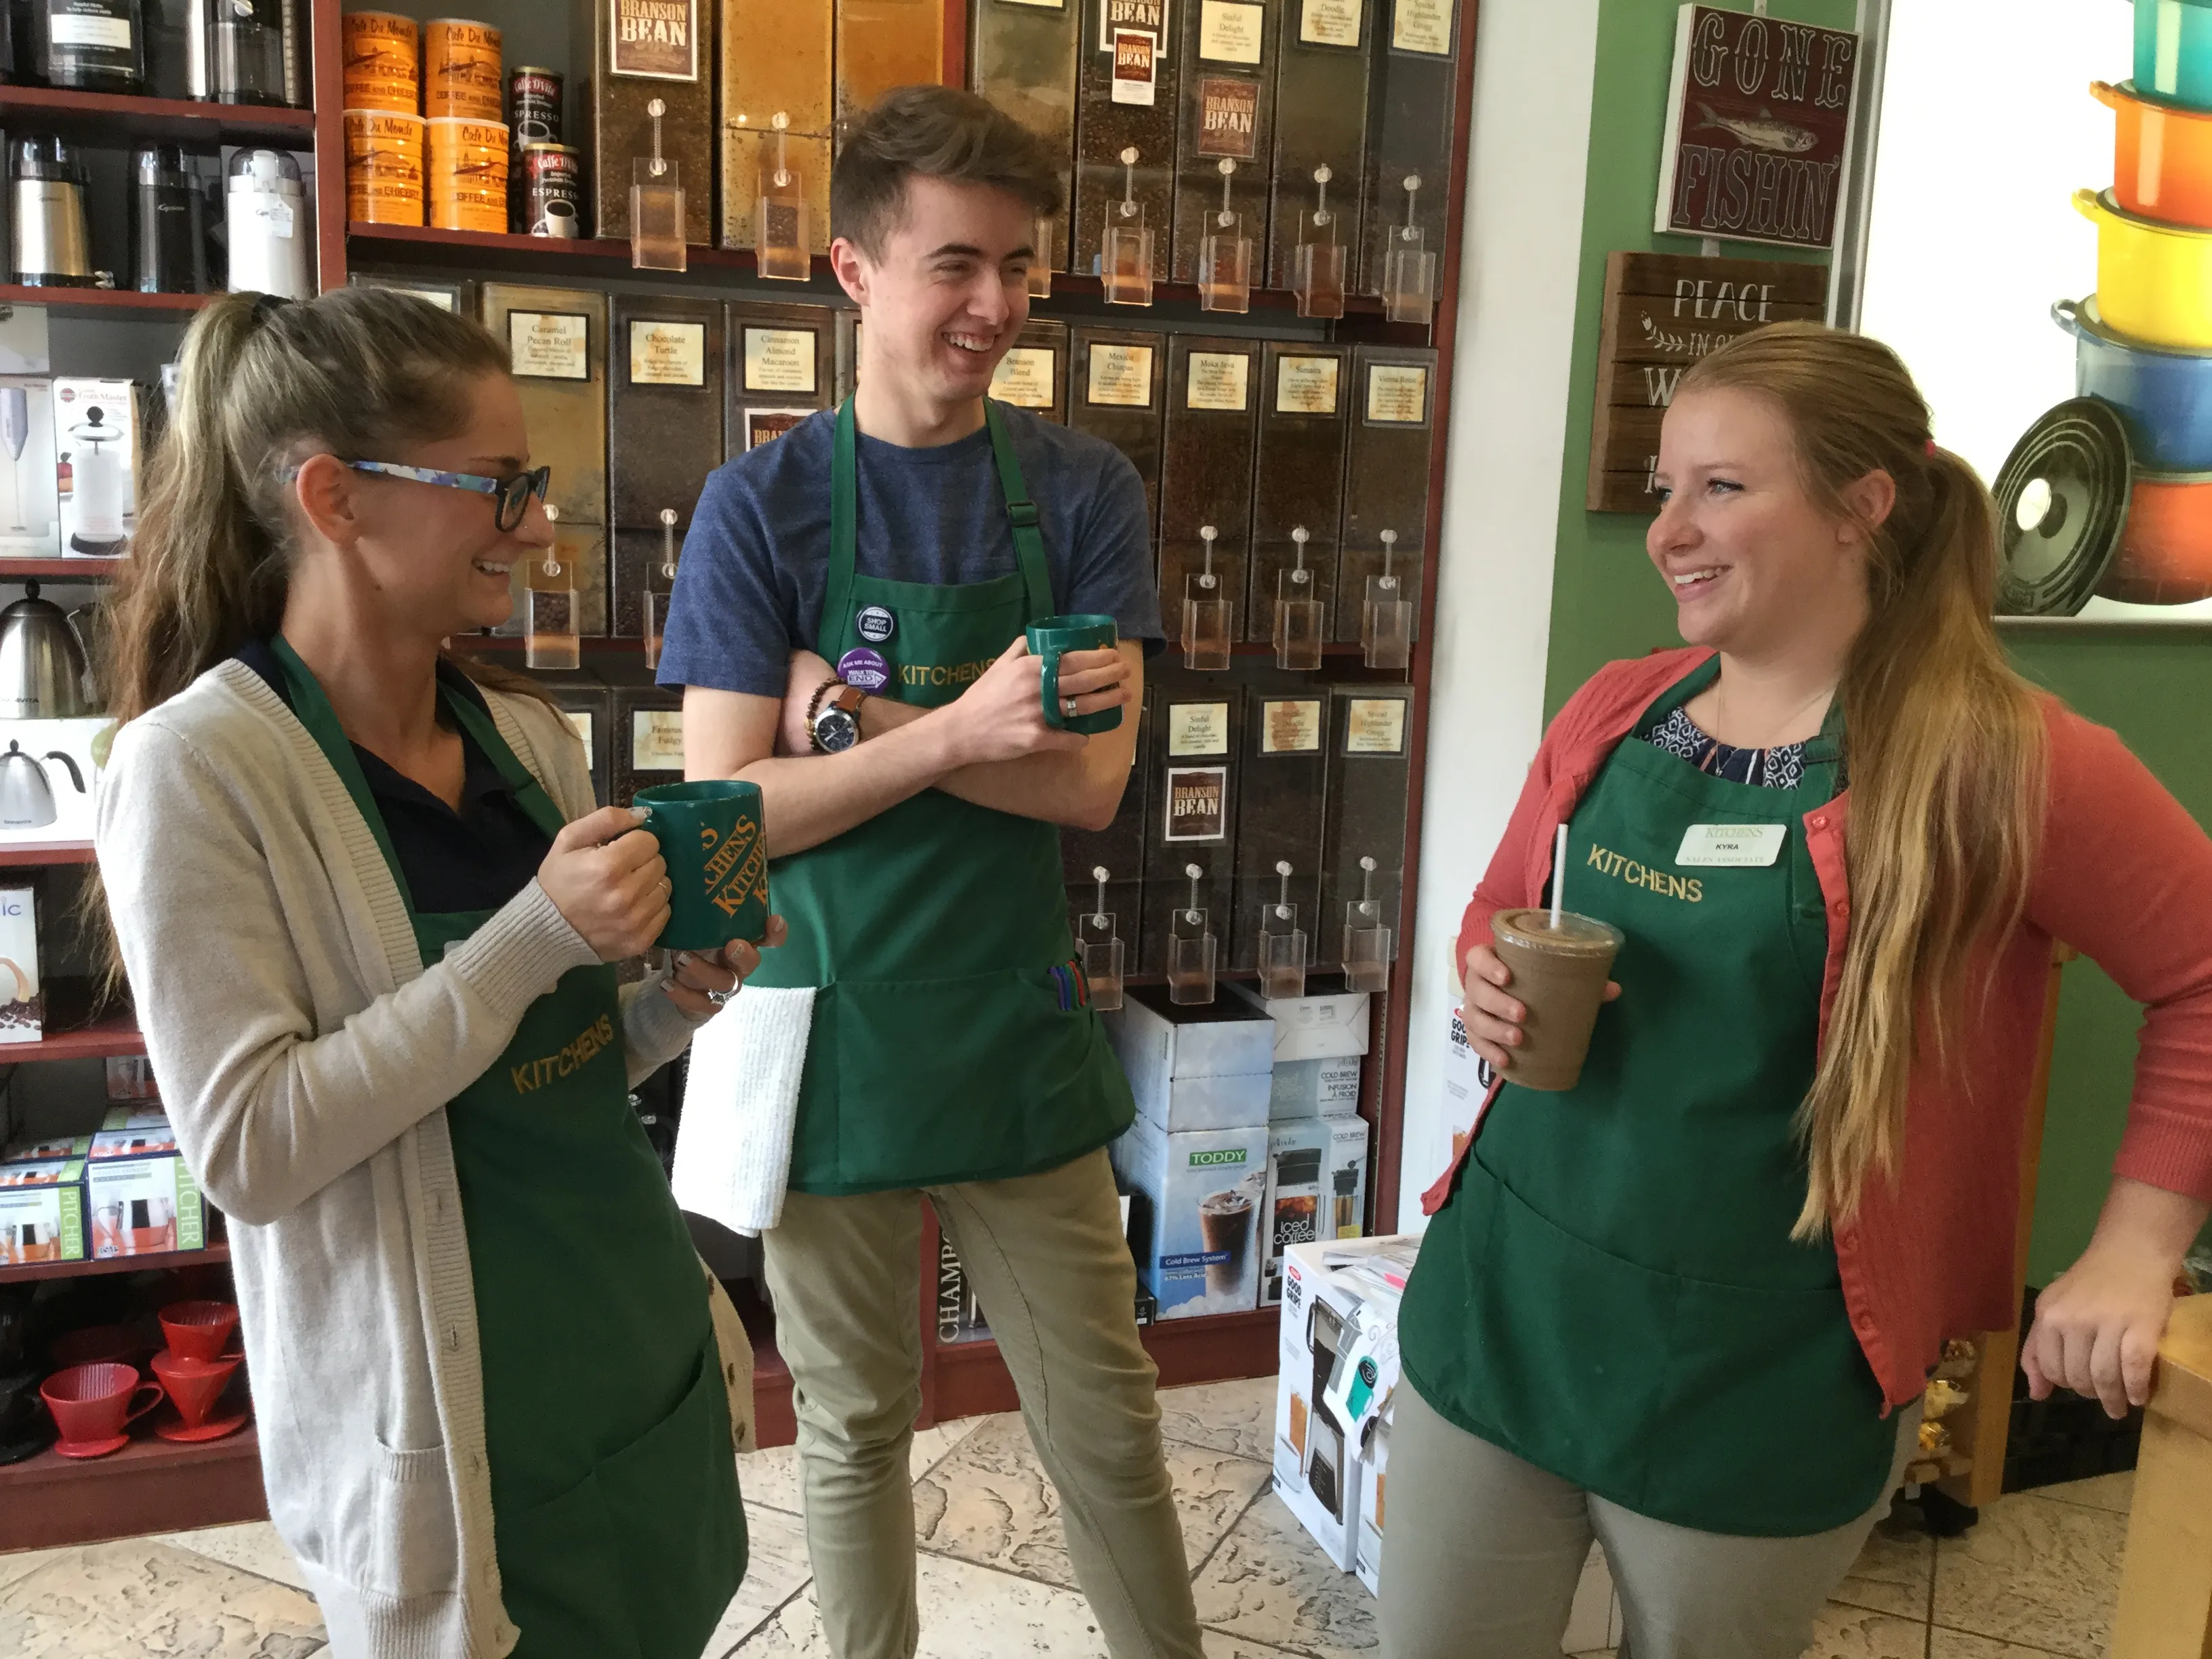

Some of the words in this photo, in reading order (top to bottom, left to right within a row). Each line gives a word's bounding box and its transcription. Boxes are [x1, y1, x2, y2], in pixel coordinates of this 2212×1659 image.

[621, 0, 687, 21] BRANSON
[1111, 1, 1160, 26] BEAN
[621, 16, 687, 46] BEAN
[1219, 23, 1244, 34] Delight
[1118, 43, 1151, 55] BRANSON
[1118, 52, 1150, 68] BEAN
[1693, 12, 1851, 108] GONE
[1206, 96, 1254, 114] BRANSON
[1204, 110, 1253, 133] BEAN
[1672, 142, 1841, 242] FISHIN'
[1674, 279, 1776, 323] PEACE
[532, 325, 567, 335] Caramel
[527, 335, 552, 346] Pecan
[554, 337, 571, 346] Roll
[645, 333, 686, 344] Chocolate
[761, 335, 800, 344] Cinnamon
[654, 346, 678, 354] Turtle
[1687, 332, 1711, 357] IN
[766, 346, 796, 355] Almond
[762, 357, 800, 367] Macaroon
[1006, 356, 1035, 366] Branson
[1108, 352, 1134, 361] Mexico
[1107, 362, 1134, 373] Chiapas
[1200, 359, 1219, 368] Moka
[1010, 368, 1031, 377] Blend
[863, 623, 887, 633] SMALL
[843, 661, 854, 669] ASK
[863, 659, 884, 668] ABOUT
[1190, 714, 1210, 724] Sinful
[652, 726, 682, 735] Famous
[1188, 724, 1212, 735] Delight
[658, 736, 682, 745] Fudgy
[1174, 785, 1220, 800] BRANSON
[1174, 798, 1220, 817] BEAN
[1706, 827, 1764, 838] KITCHENS
[1586, 844, 1703, 903] KITCHENS
[510, 1013, 613, 1094] KITCHENS
[1328, 1083, 1356, 1091] INFUSION
[1333, 1132, 1349, 1141] COLD
[1349, 1130, 1366, 1139] BREW
[1191, 1150, 1246, 1164] TODDY
[62, 1190, 80, 1256] PITCHER
[1287, 1275, 1302, 1296] GOOD
